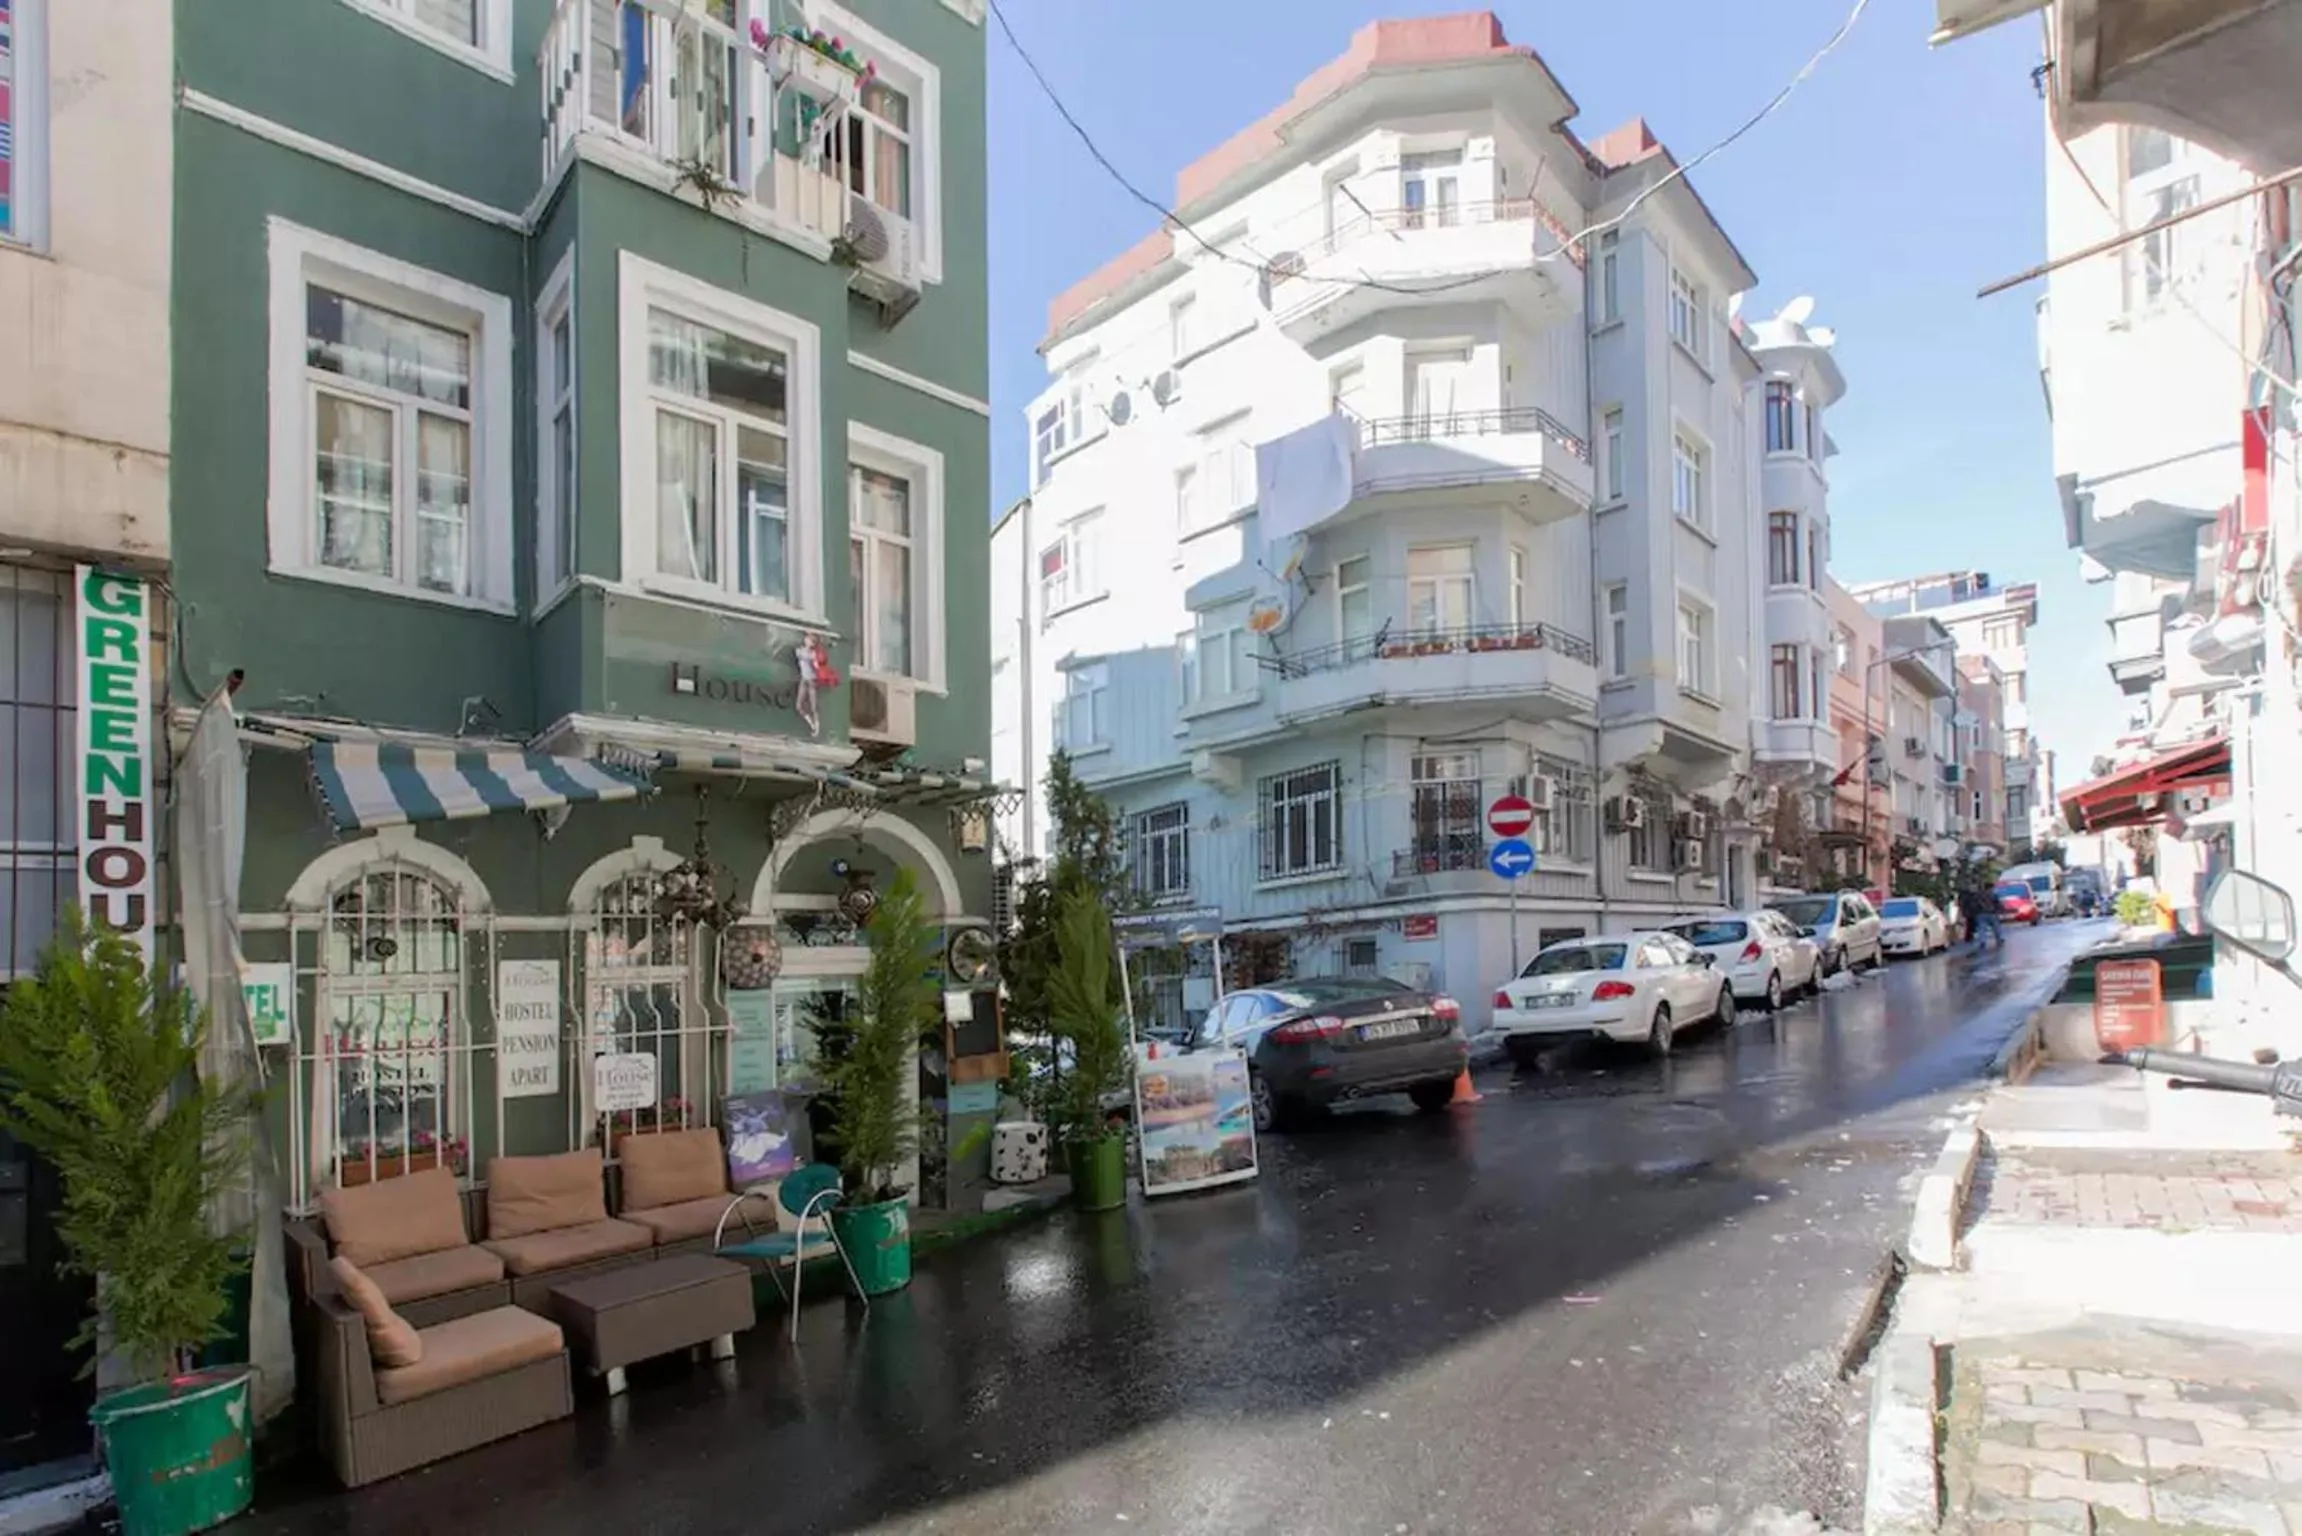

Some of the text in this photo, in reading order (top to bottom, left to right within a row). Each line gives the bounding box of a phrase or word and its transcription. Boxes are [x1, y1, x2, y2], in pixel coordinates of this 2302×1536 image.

[504, 1002, 553, 1021] HOSTEL
[503, 1034, 556, 1053] PENSION
[511, 1066, 550, 1087] APART
